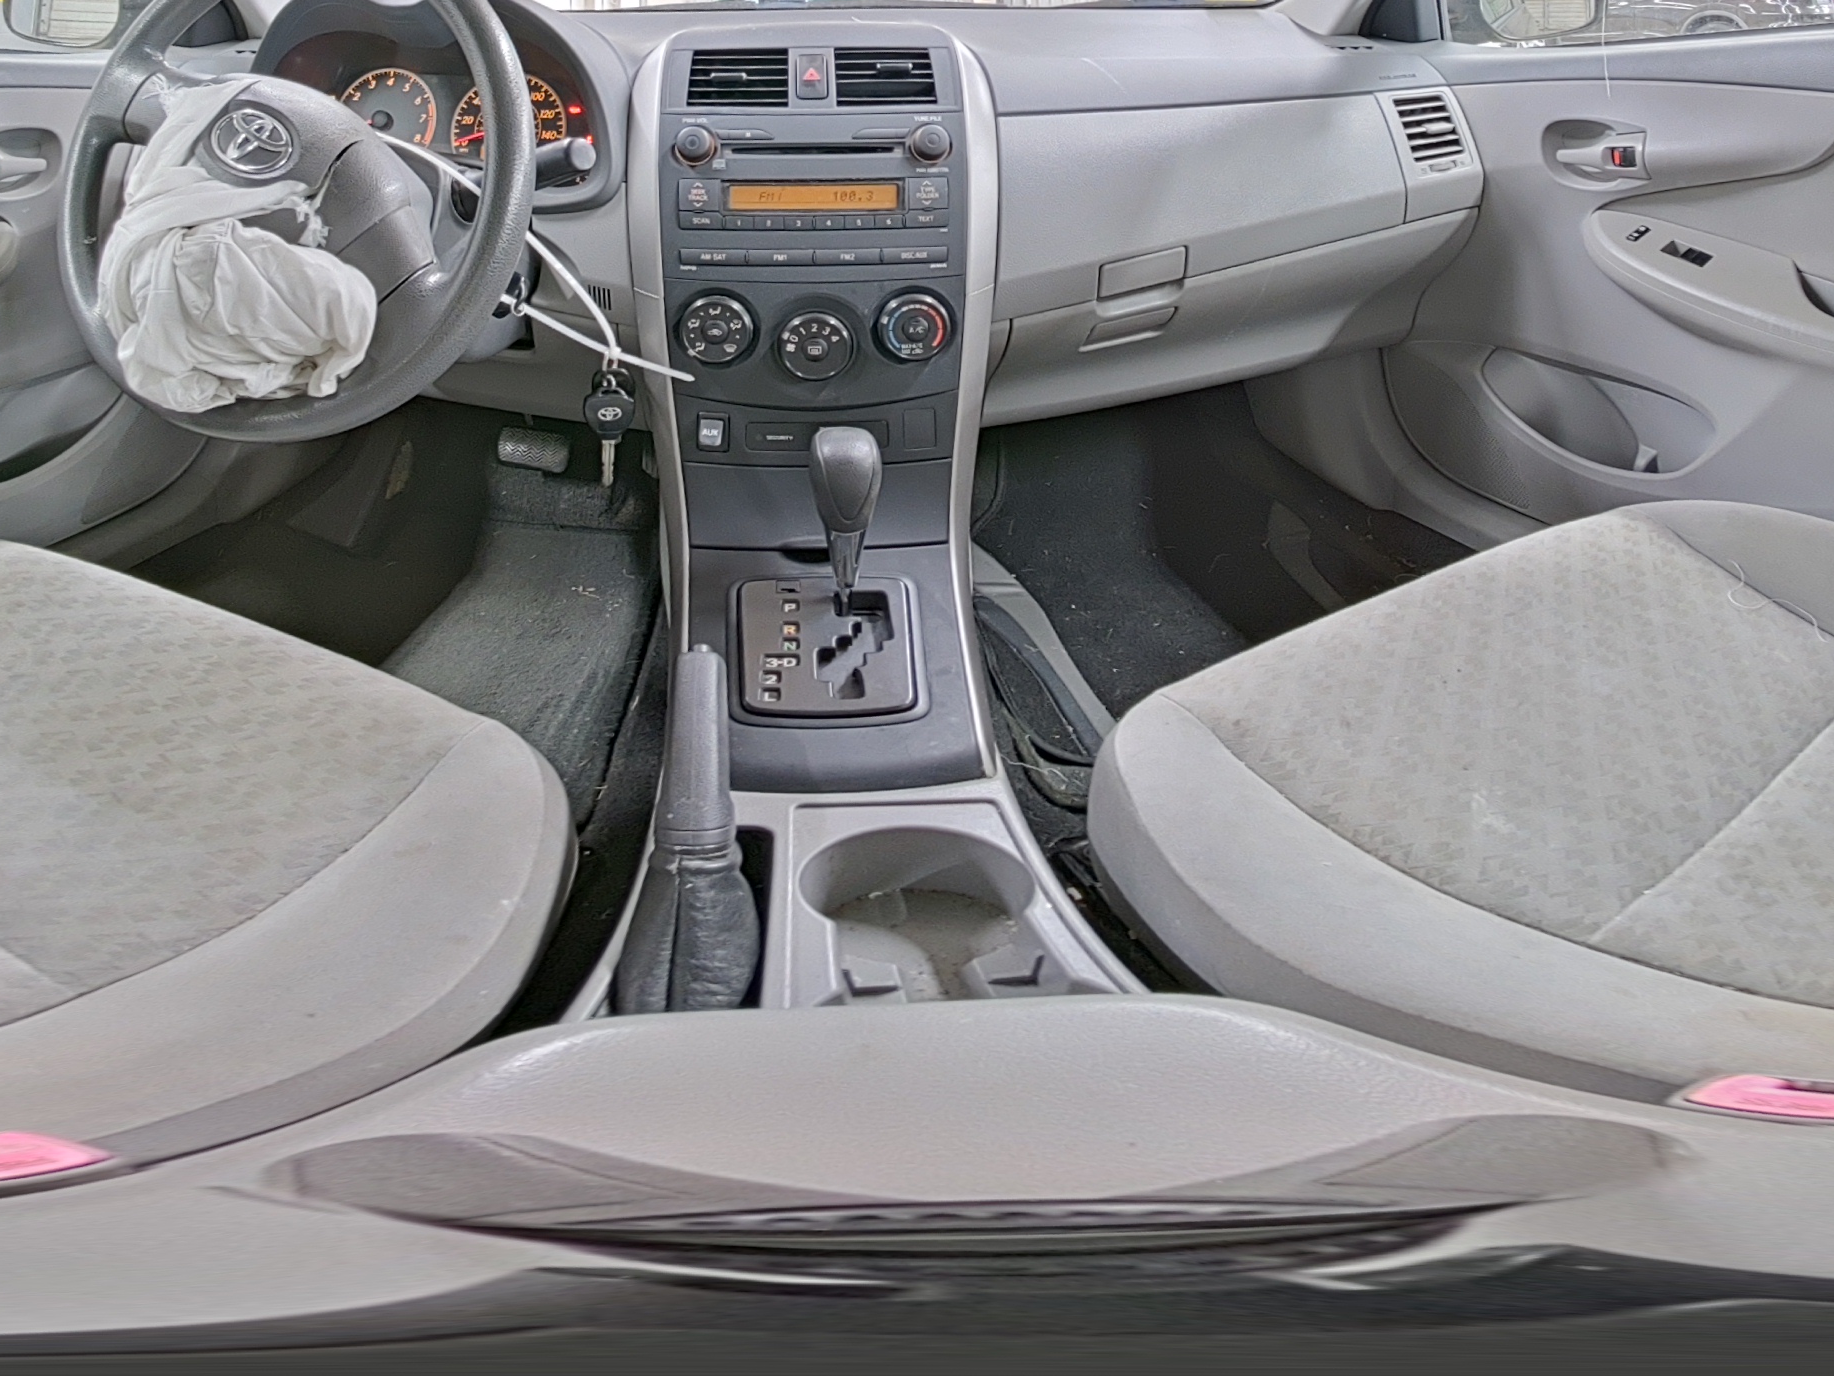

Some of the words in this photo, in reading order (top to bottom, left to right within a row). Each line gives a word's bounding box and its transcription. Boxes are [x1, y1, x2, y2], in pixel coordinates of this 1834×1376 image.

[368, 80, 377, 90] 3
[386, 77, 396, 87] 4
[402, 83, 412, 93] 5
[352, 92, 361, 102] 2
[414, 96, 423, 106] 6
[419, 114, 427, 124] 7
[539, 110, 556, 119] 120
[461, 116, 474, 125] 20
[413, 133, 422, 143] 8
[541, 130, 557, 140] 140
[833, 190, 874, 202] 100.3
[691, 217, 711, 225] SCAN
[840, 253, 855, 261] FM2
[799, 327, 806, 336] 1
[811, 324, 818, 332] 2
[822, 326, 831, 336] 3
[831, 335, 840, 343] 4
[908, 325, 925, 334] A/C
[701, 428, 719, 437] AUX
[784, 603, 796, 613] P
[783, 625, 797, 636] R
[784, 641, 797, 651] N
[765, 657, 797, 668] 3-D
[765, 674, 778, 685] 2
[765, 691, 777, 702] L
